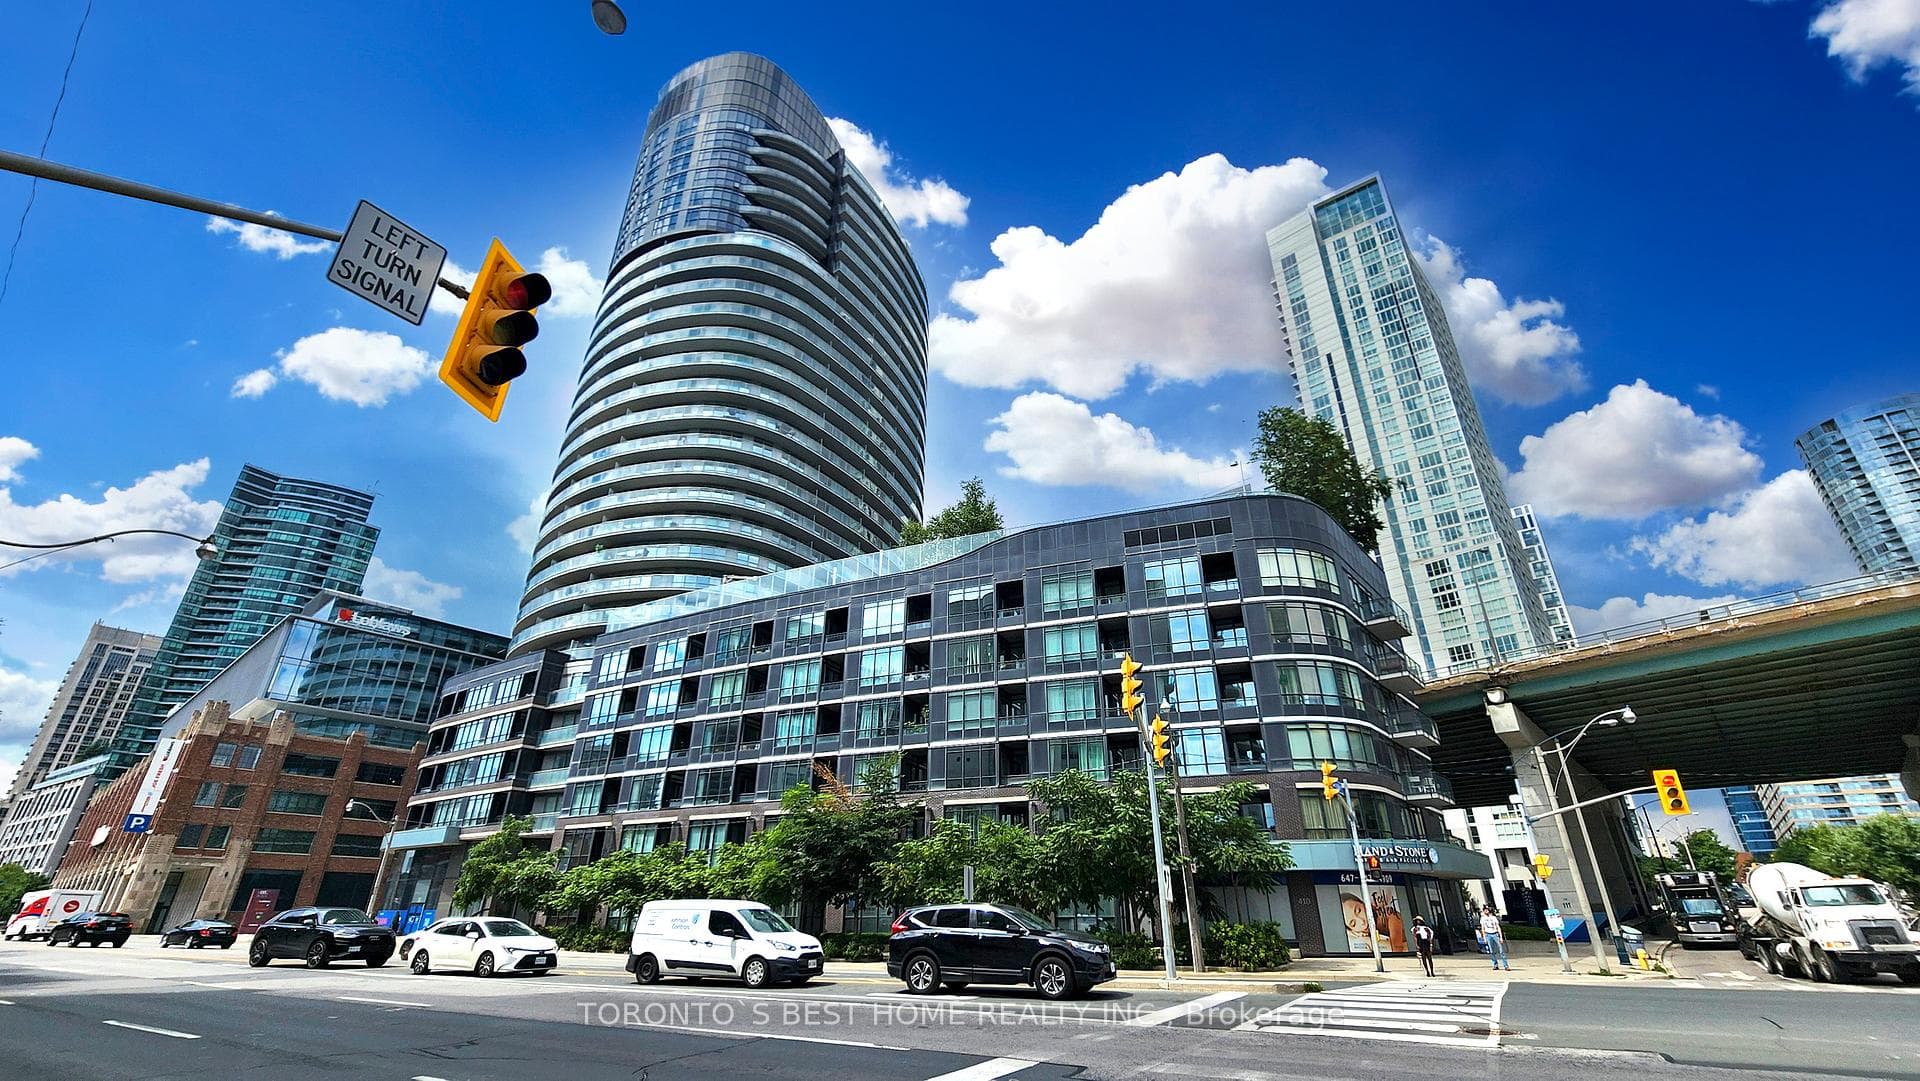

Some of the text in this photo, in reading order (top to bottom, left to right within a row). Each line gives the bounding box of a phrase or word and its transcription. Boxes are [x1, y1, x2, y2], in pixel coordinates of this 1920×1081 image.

[370, 216, 429, 260] LEFT
[362, 239, 422, 287] TURN
[336, 259, 418, 317] SIGNAL
[130, 817, 145, 829] P
